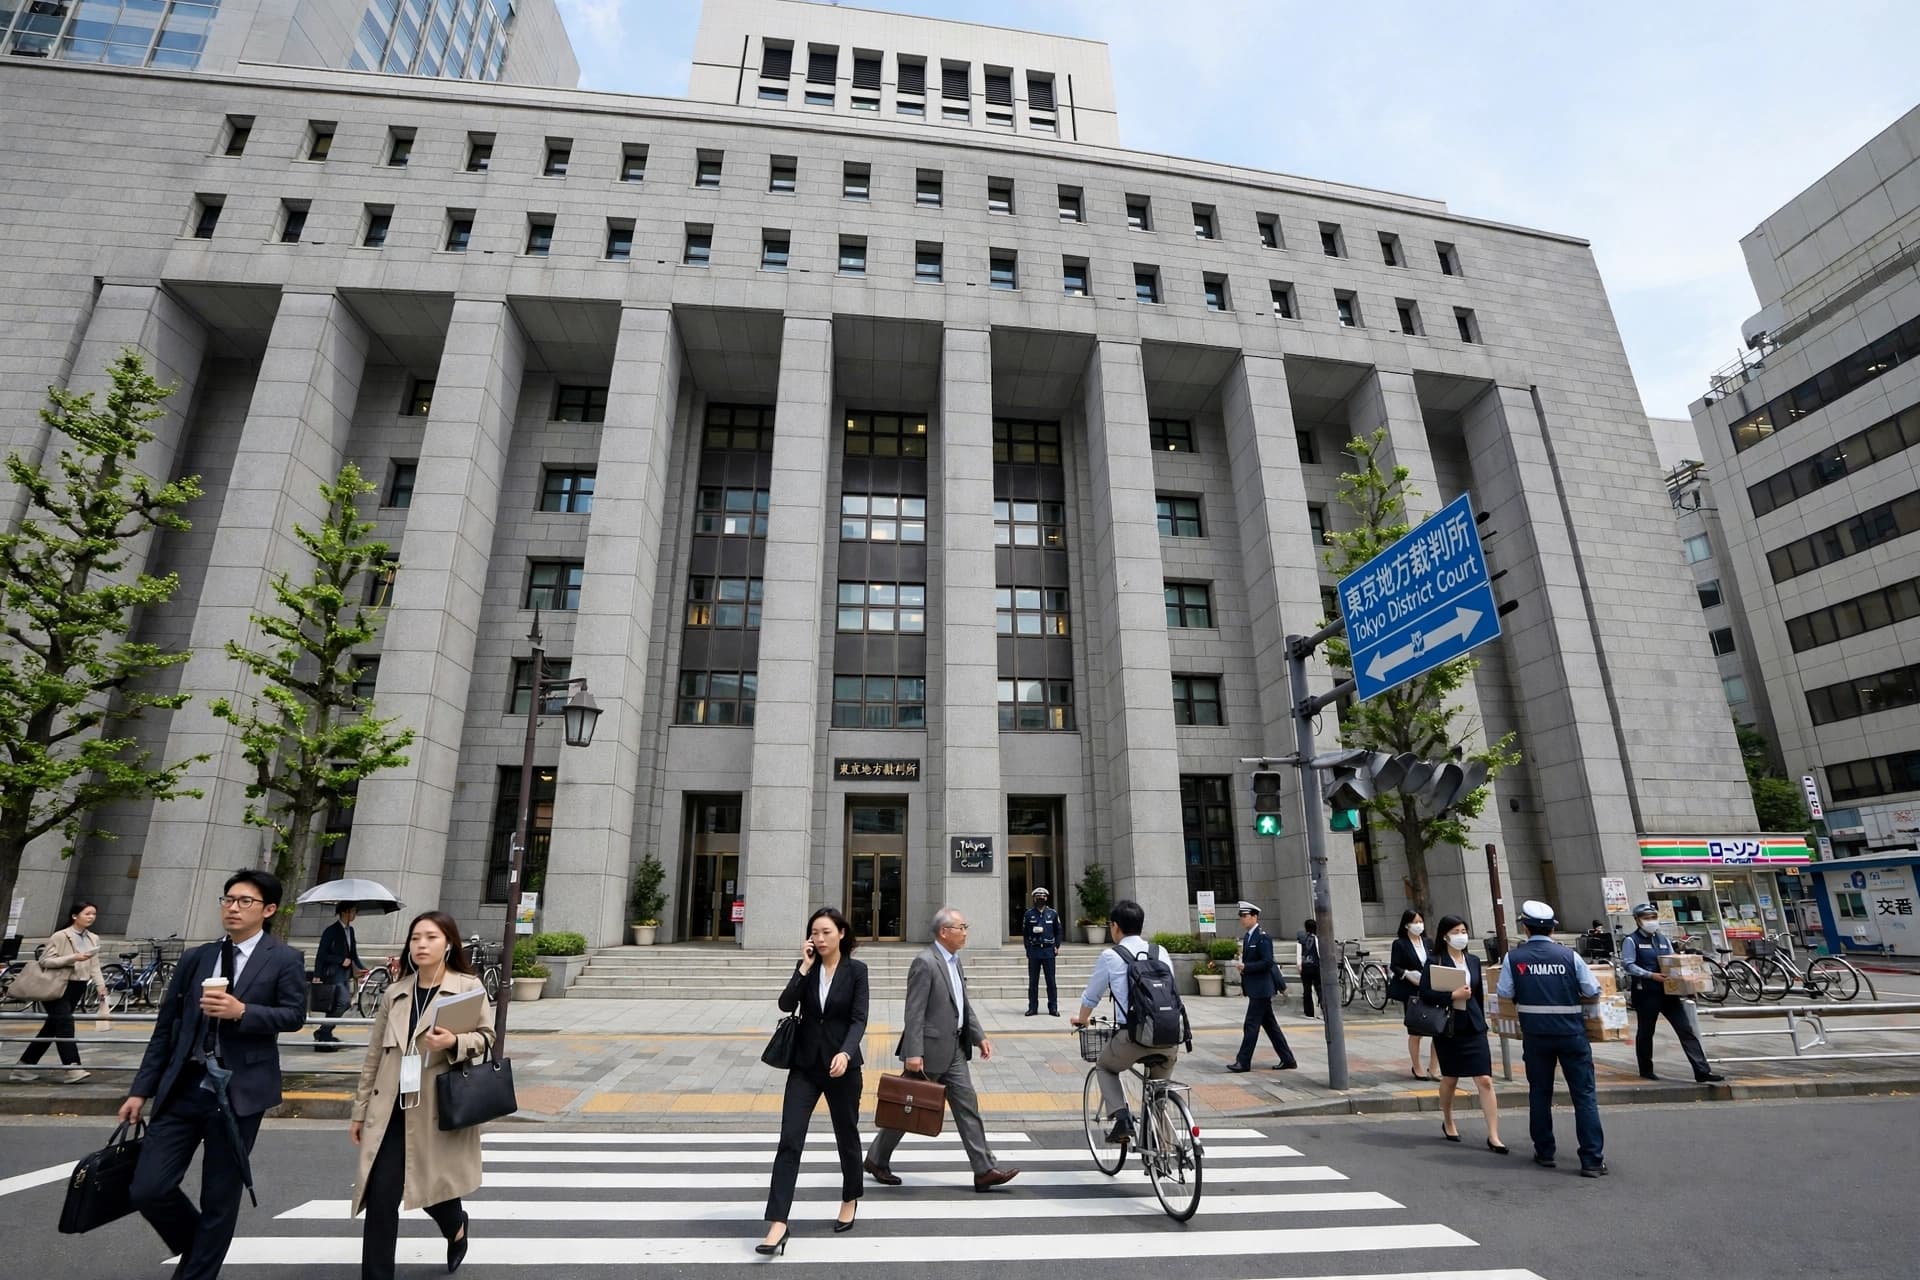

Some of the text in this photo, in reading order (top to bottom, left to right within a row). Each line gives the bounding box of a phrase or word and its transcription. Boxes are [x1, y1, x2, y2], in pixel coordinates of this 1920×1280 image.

[1344, 510, 1471, 620] 東京地方裁判所
[1352, 553, 1478, 642] Tokyo District Court
[1709, 842, 1760, 857] ローソン
[1527, 963, 1566, 975] YAMATO
